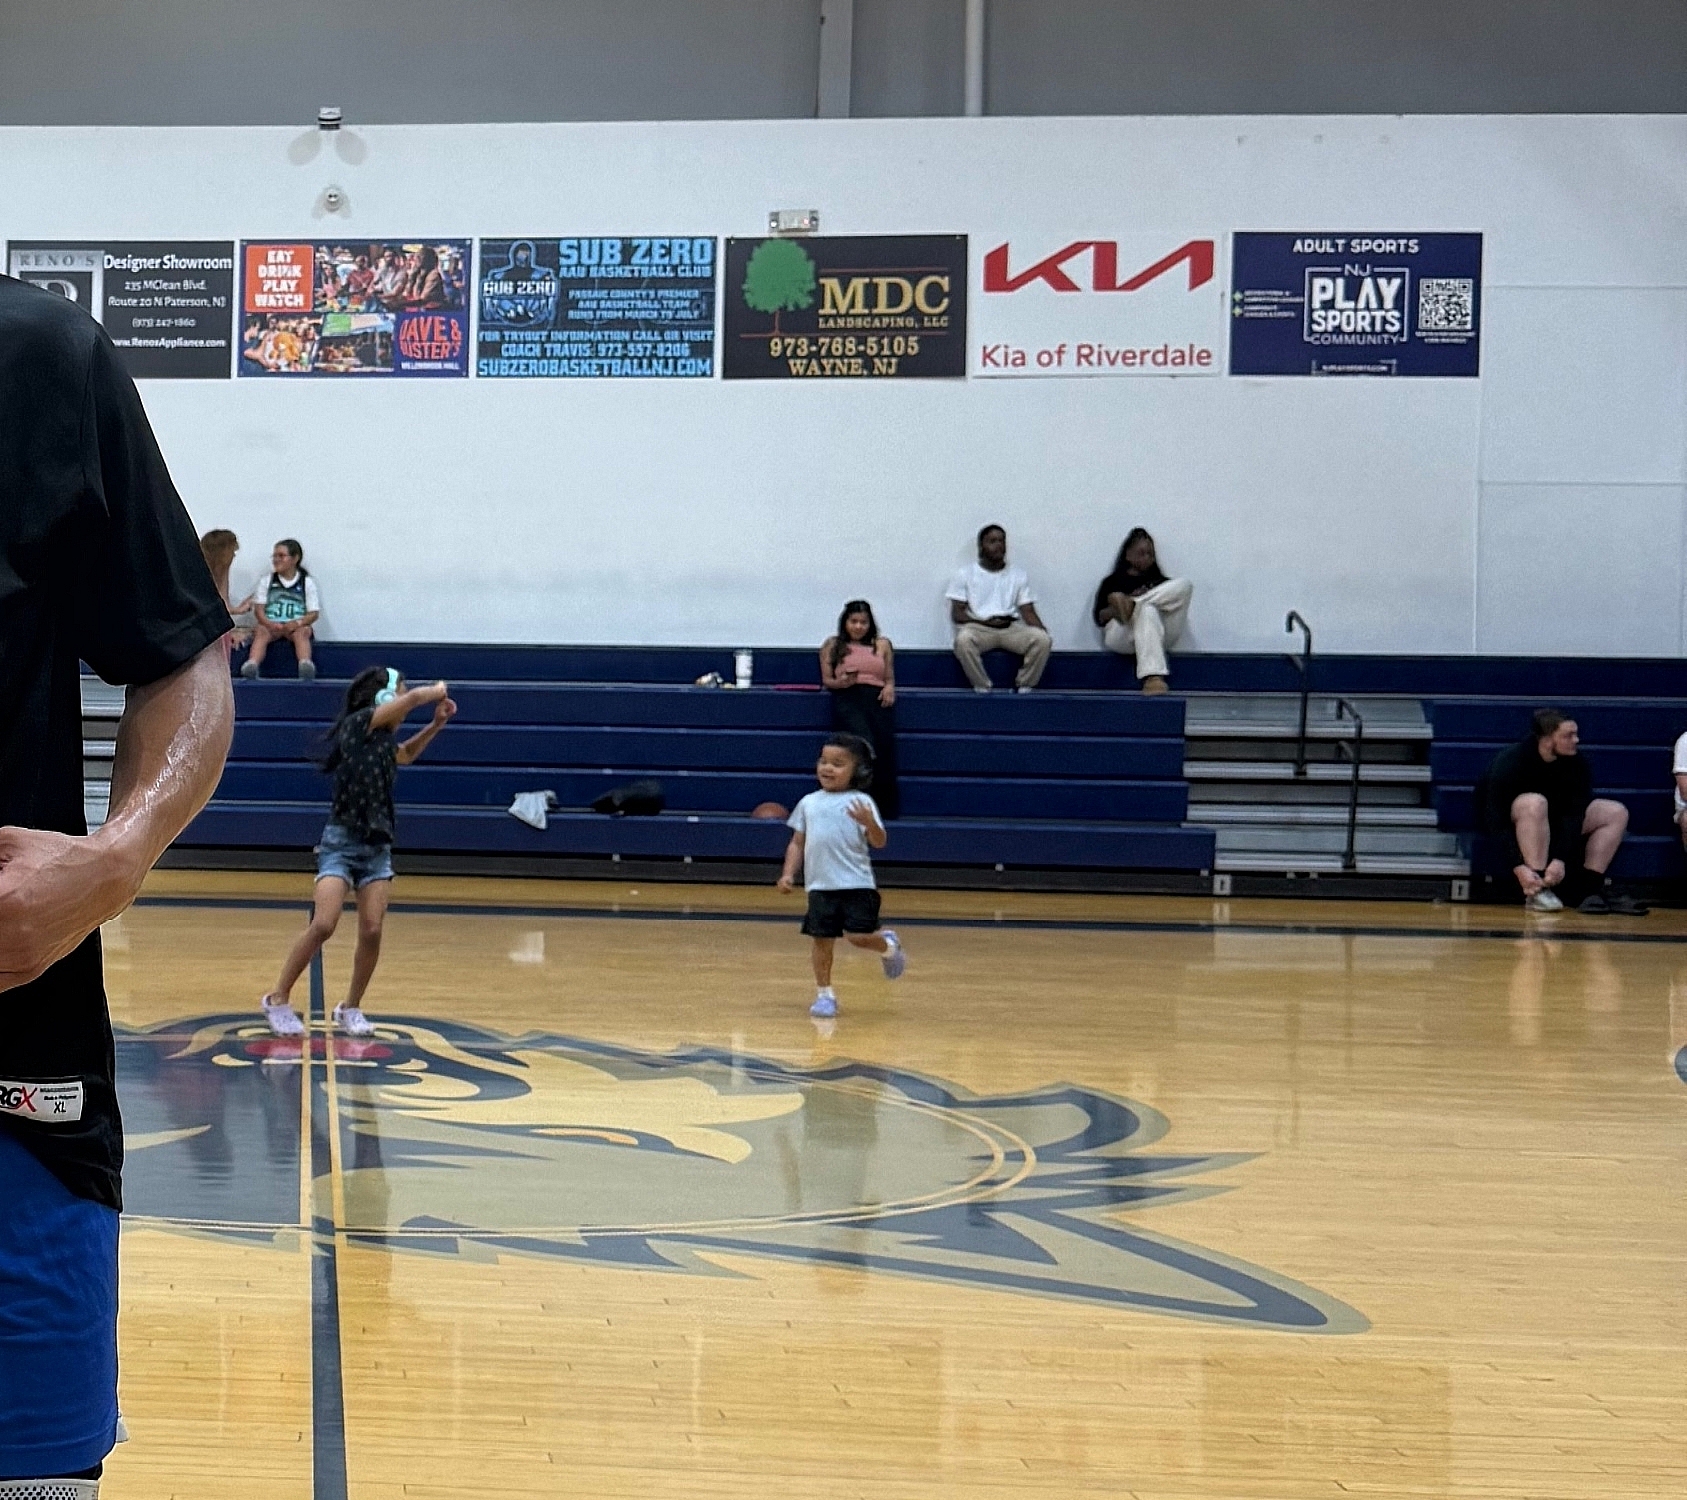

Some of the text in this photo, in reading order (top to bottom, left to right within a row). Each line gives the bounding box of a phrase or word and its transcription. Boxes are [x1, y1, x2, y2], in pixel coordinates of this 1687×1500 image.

[559, 239, 712, 265] SUB ZERO
[1292, 239, 1420, 254] ADULT SPORTS
[103, 255, 232, 272] Designer Showroom
[267, 250, 294, 264] EAT
[258, 265, 302, 279] DRINK
[589, 266, 675, 278] BASKETBALL
[677, 266, 712, 278] CLUB
[983, 240, 1215, 292] KIA
[1344, 264, 1371, 276] NJ
[262, 279, 298, 293] PLAY
[483, 280, 555, 297] SUB ZERO
[818, 275, 950, 316] MDC
[1311, 277, 1402, 310] PLAY
[108, 296, 138, 306] Route
[153, 297, 163, 306] N
[254, 294, 304, 308] WATCH
[818, 316, 949, 329] LANDSCAPING, LLC
[1311, 310, 1401, 333] SPORTS
[632, 331, 662, 342] CALL
[1311, 334, 1399, 345] COMMUNITY
[500, 343, 541, 357] COACH
[769, 336, 920, 357] 973-768-5105
[981, 343, 1213, 367] Kia of Riverdale
[478, 358, 711, 377] SUBZEROBASKETBALLNJ.COM
[788, 358, 899, 376] WAYNE, NJ
[53, 1100, 67, 1114] XL
